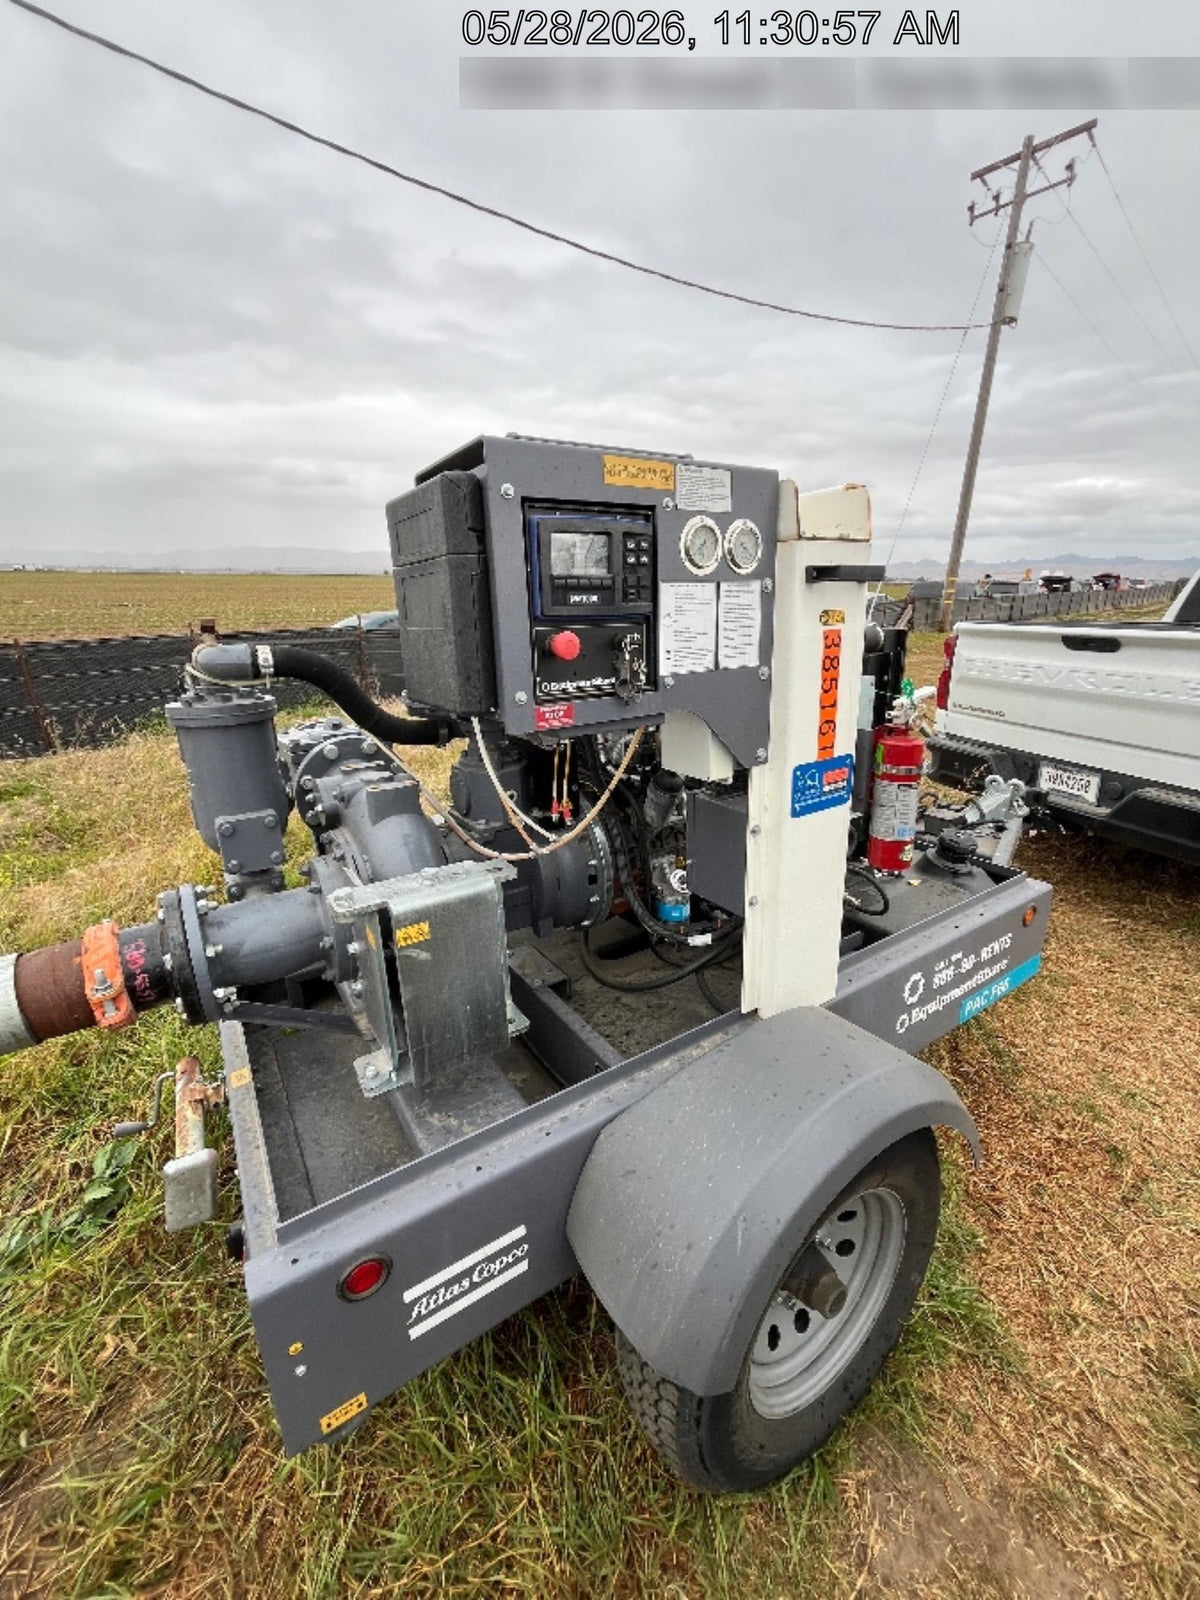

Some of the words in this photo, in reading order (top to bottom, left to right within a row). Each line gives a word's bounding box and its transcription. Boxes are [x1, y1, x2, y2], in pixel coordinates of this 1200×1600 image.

[817, 629, 842, 754] 385161
[406, 1276, 470, 1325] Atlas
[472, 1243, 529, 1284] Copco
